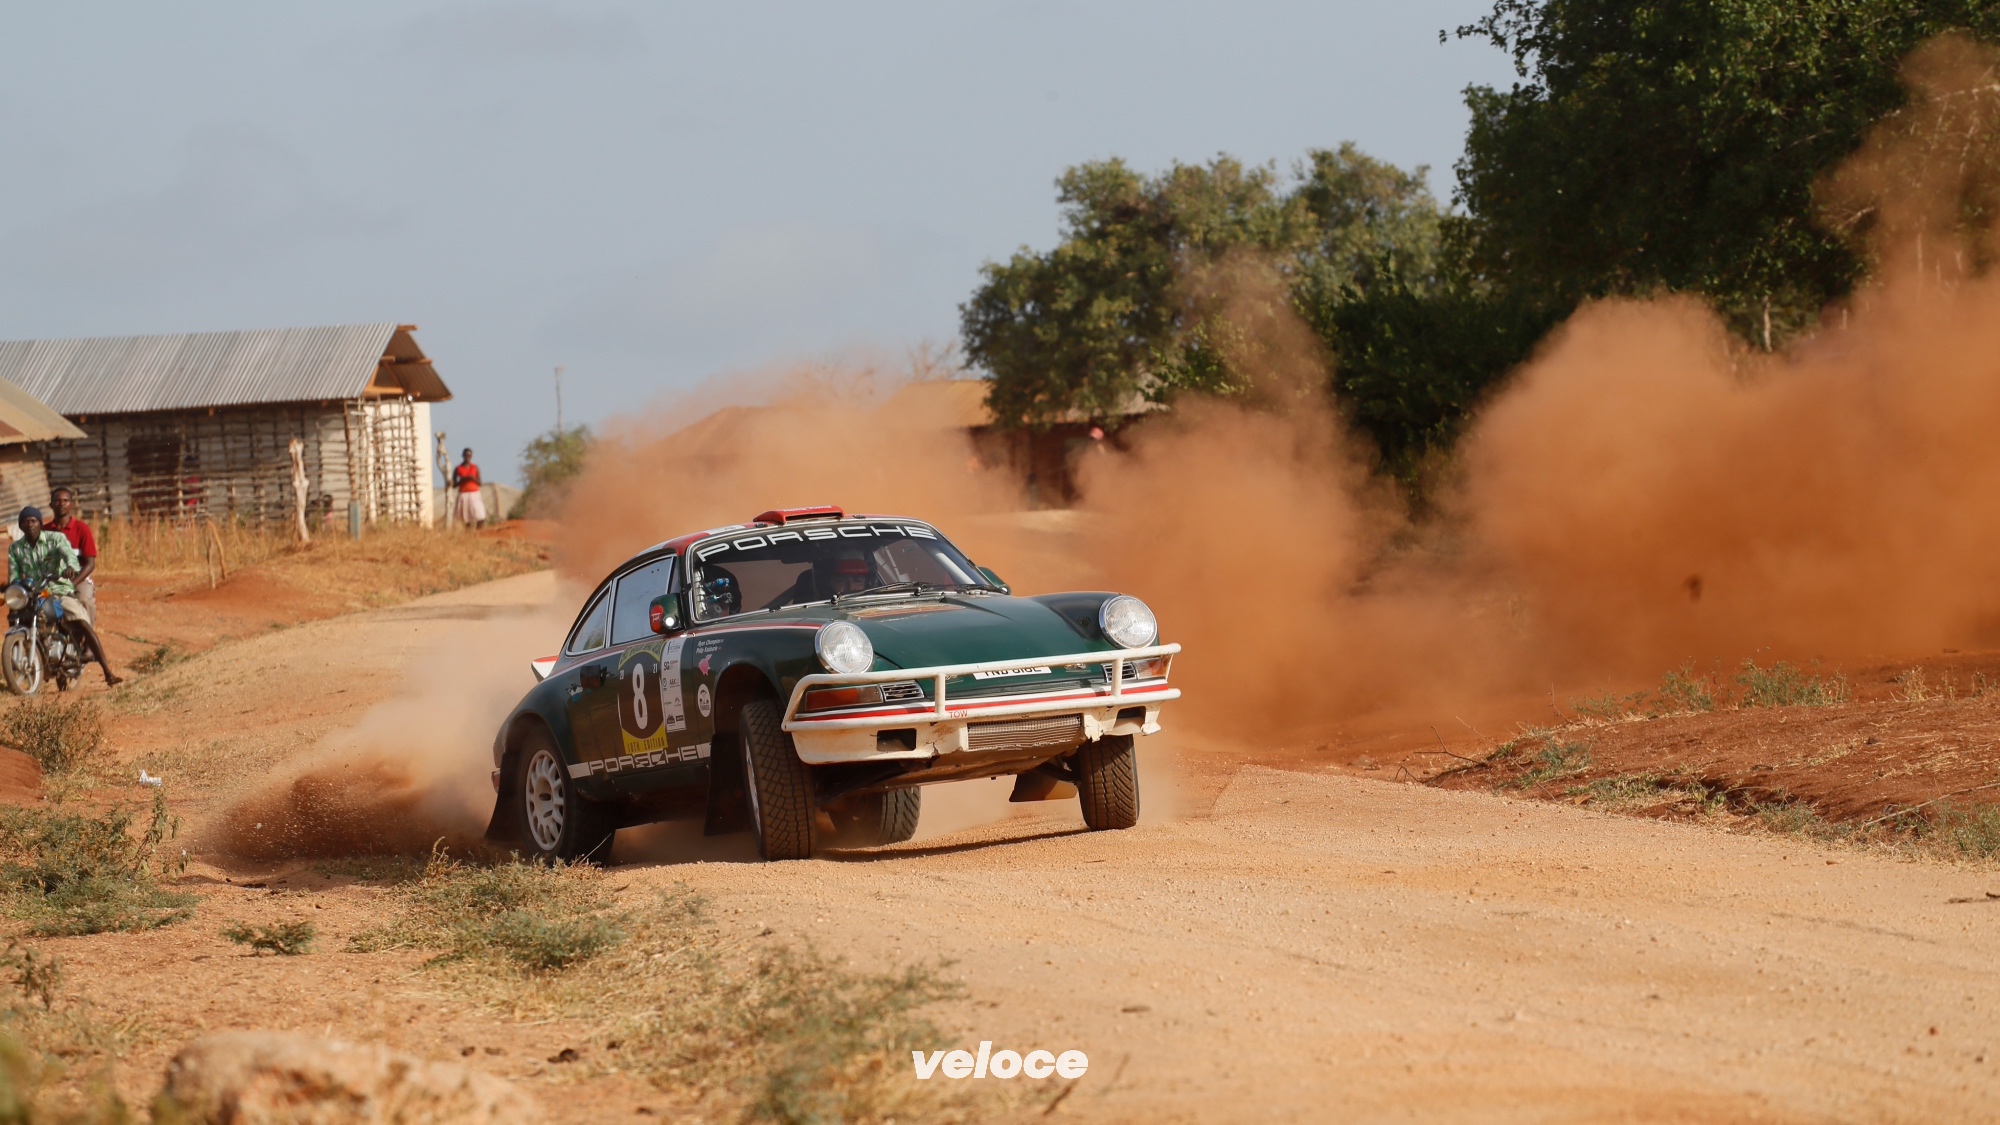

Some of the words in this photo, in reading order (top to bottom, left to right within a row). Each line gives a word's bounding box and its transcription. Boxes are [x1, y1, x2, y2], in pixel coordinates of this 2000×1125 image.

[696, 526, 938, 562] PORSCHE
[632, 662, 648, 730] 8
[949, 710, 968, 718] TOW
[589, 745, 698, 775] PORSCHE
